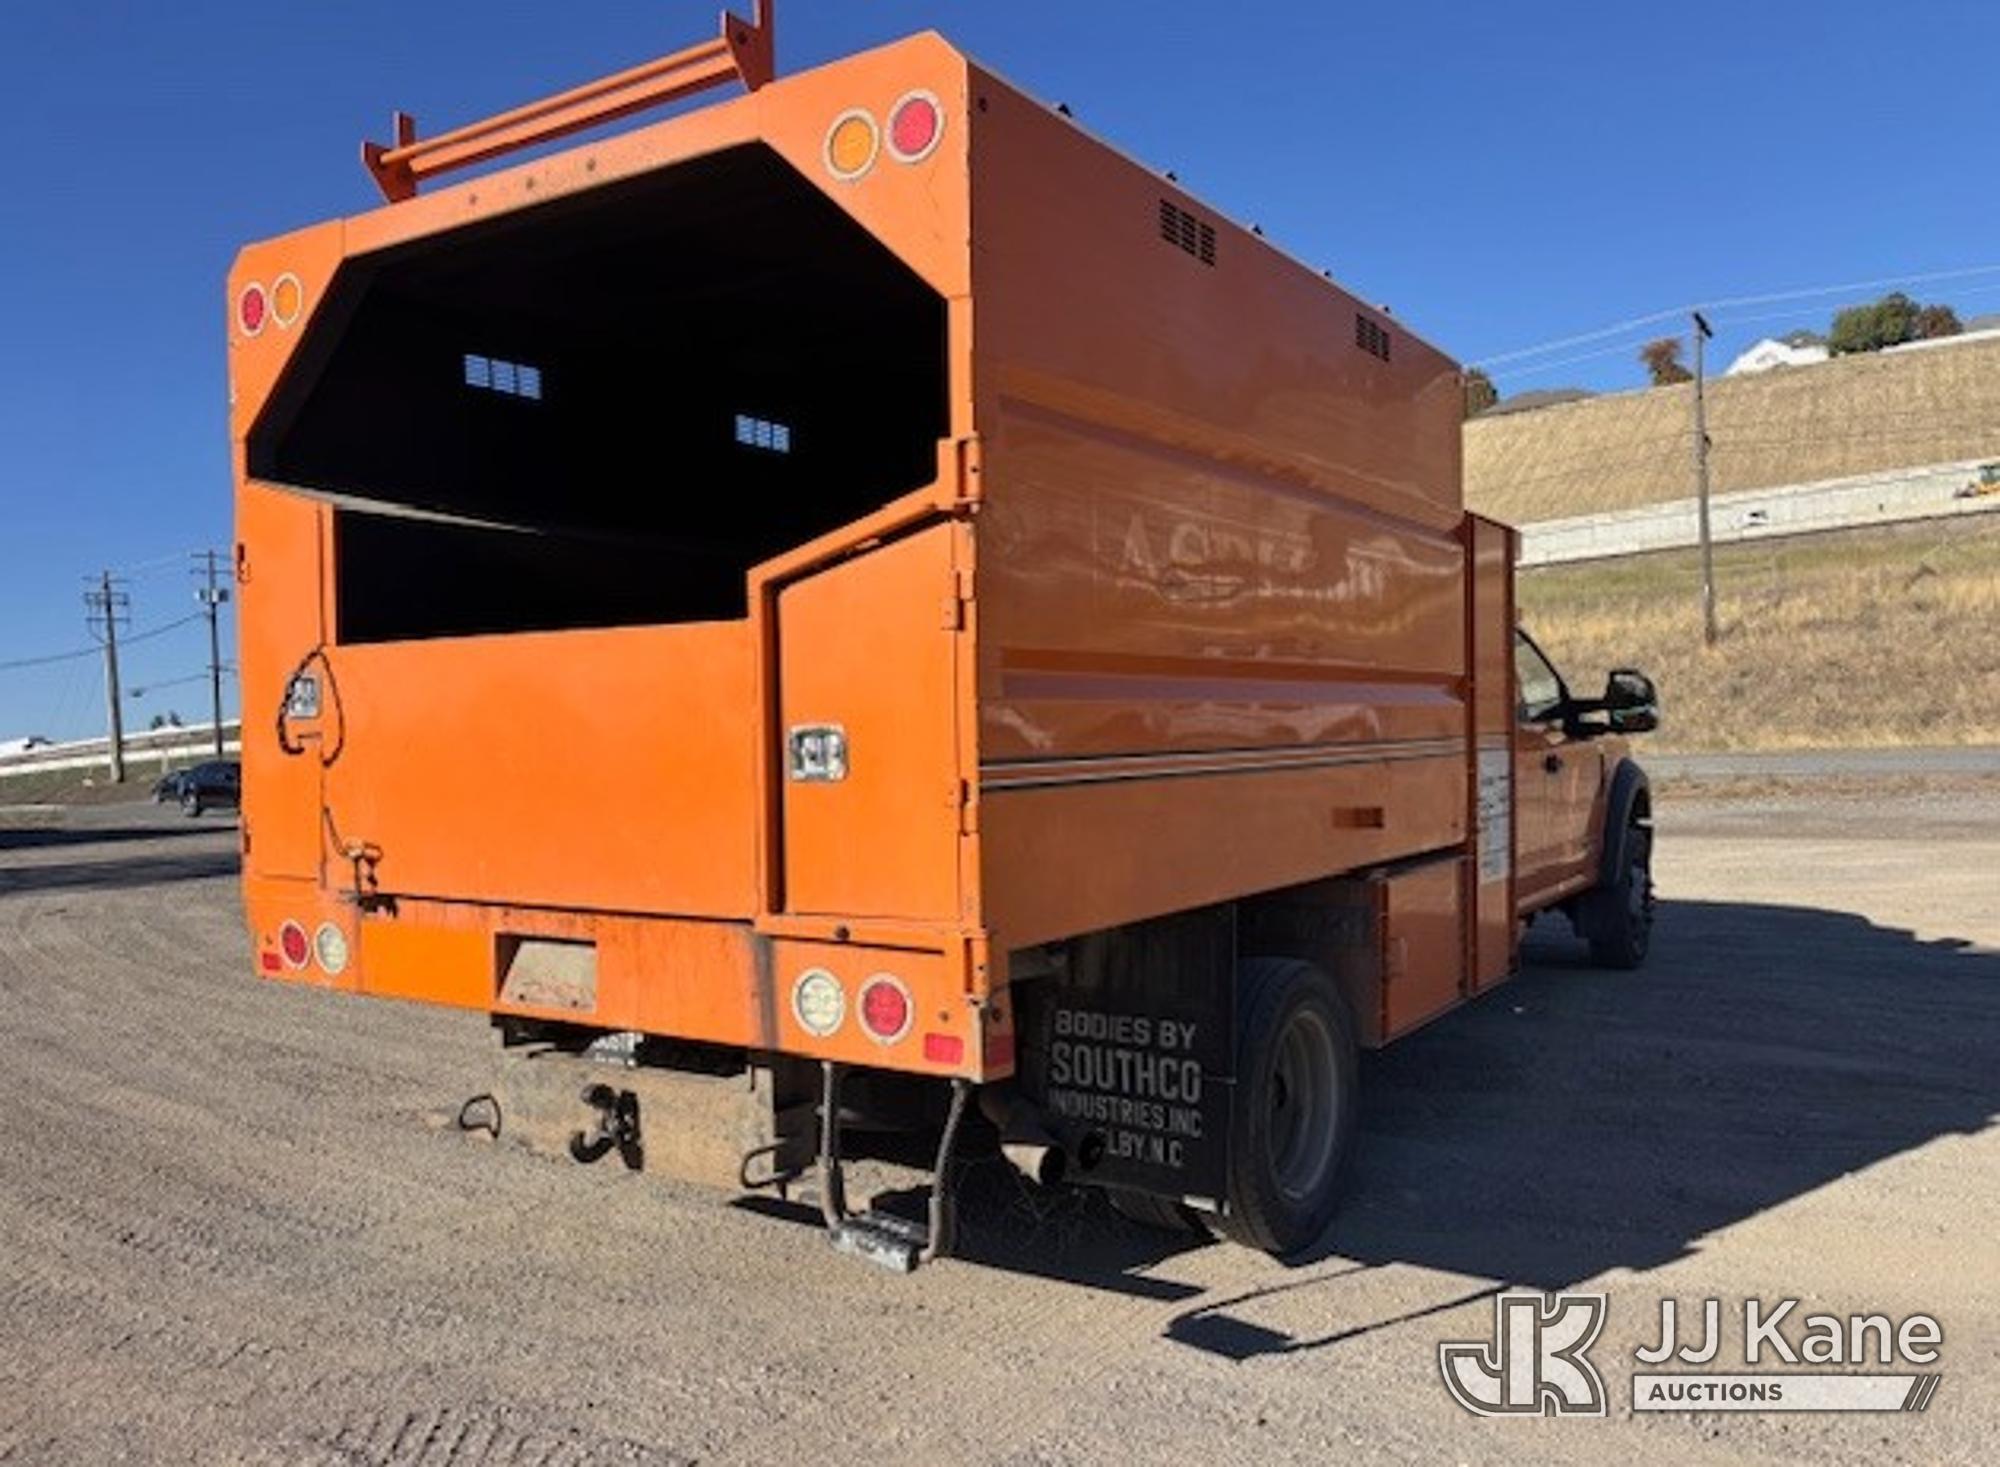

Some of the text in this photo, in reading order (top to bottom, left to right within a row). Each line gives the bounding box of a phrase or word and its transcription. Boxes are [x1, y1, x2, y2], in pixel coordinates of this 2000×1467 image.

[1054, 1009, 1197, 1050] BODIES BY
[1050, 1040, 1203, 1104] SOUTHCO
